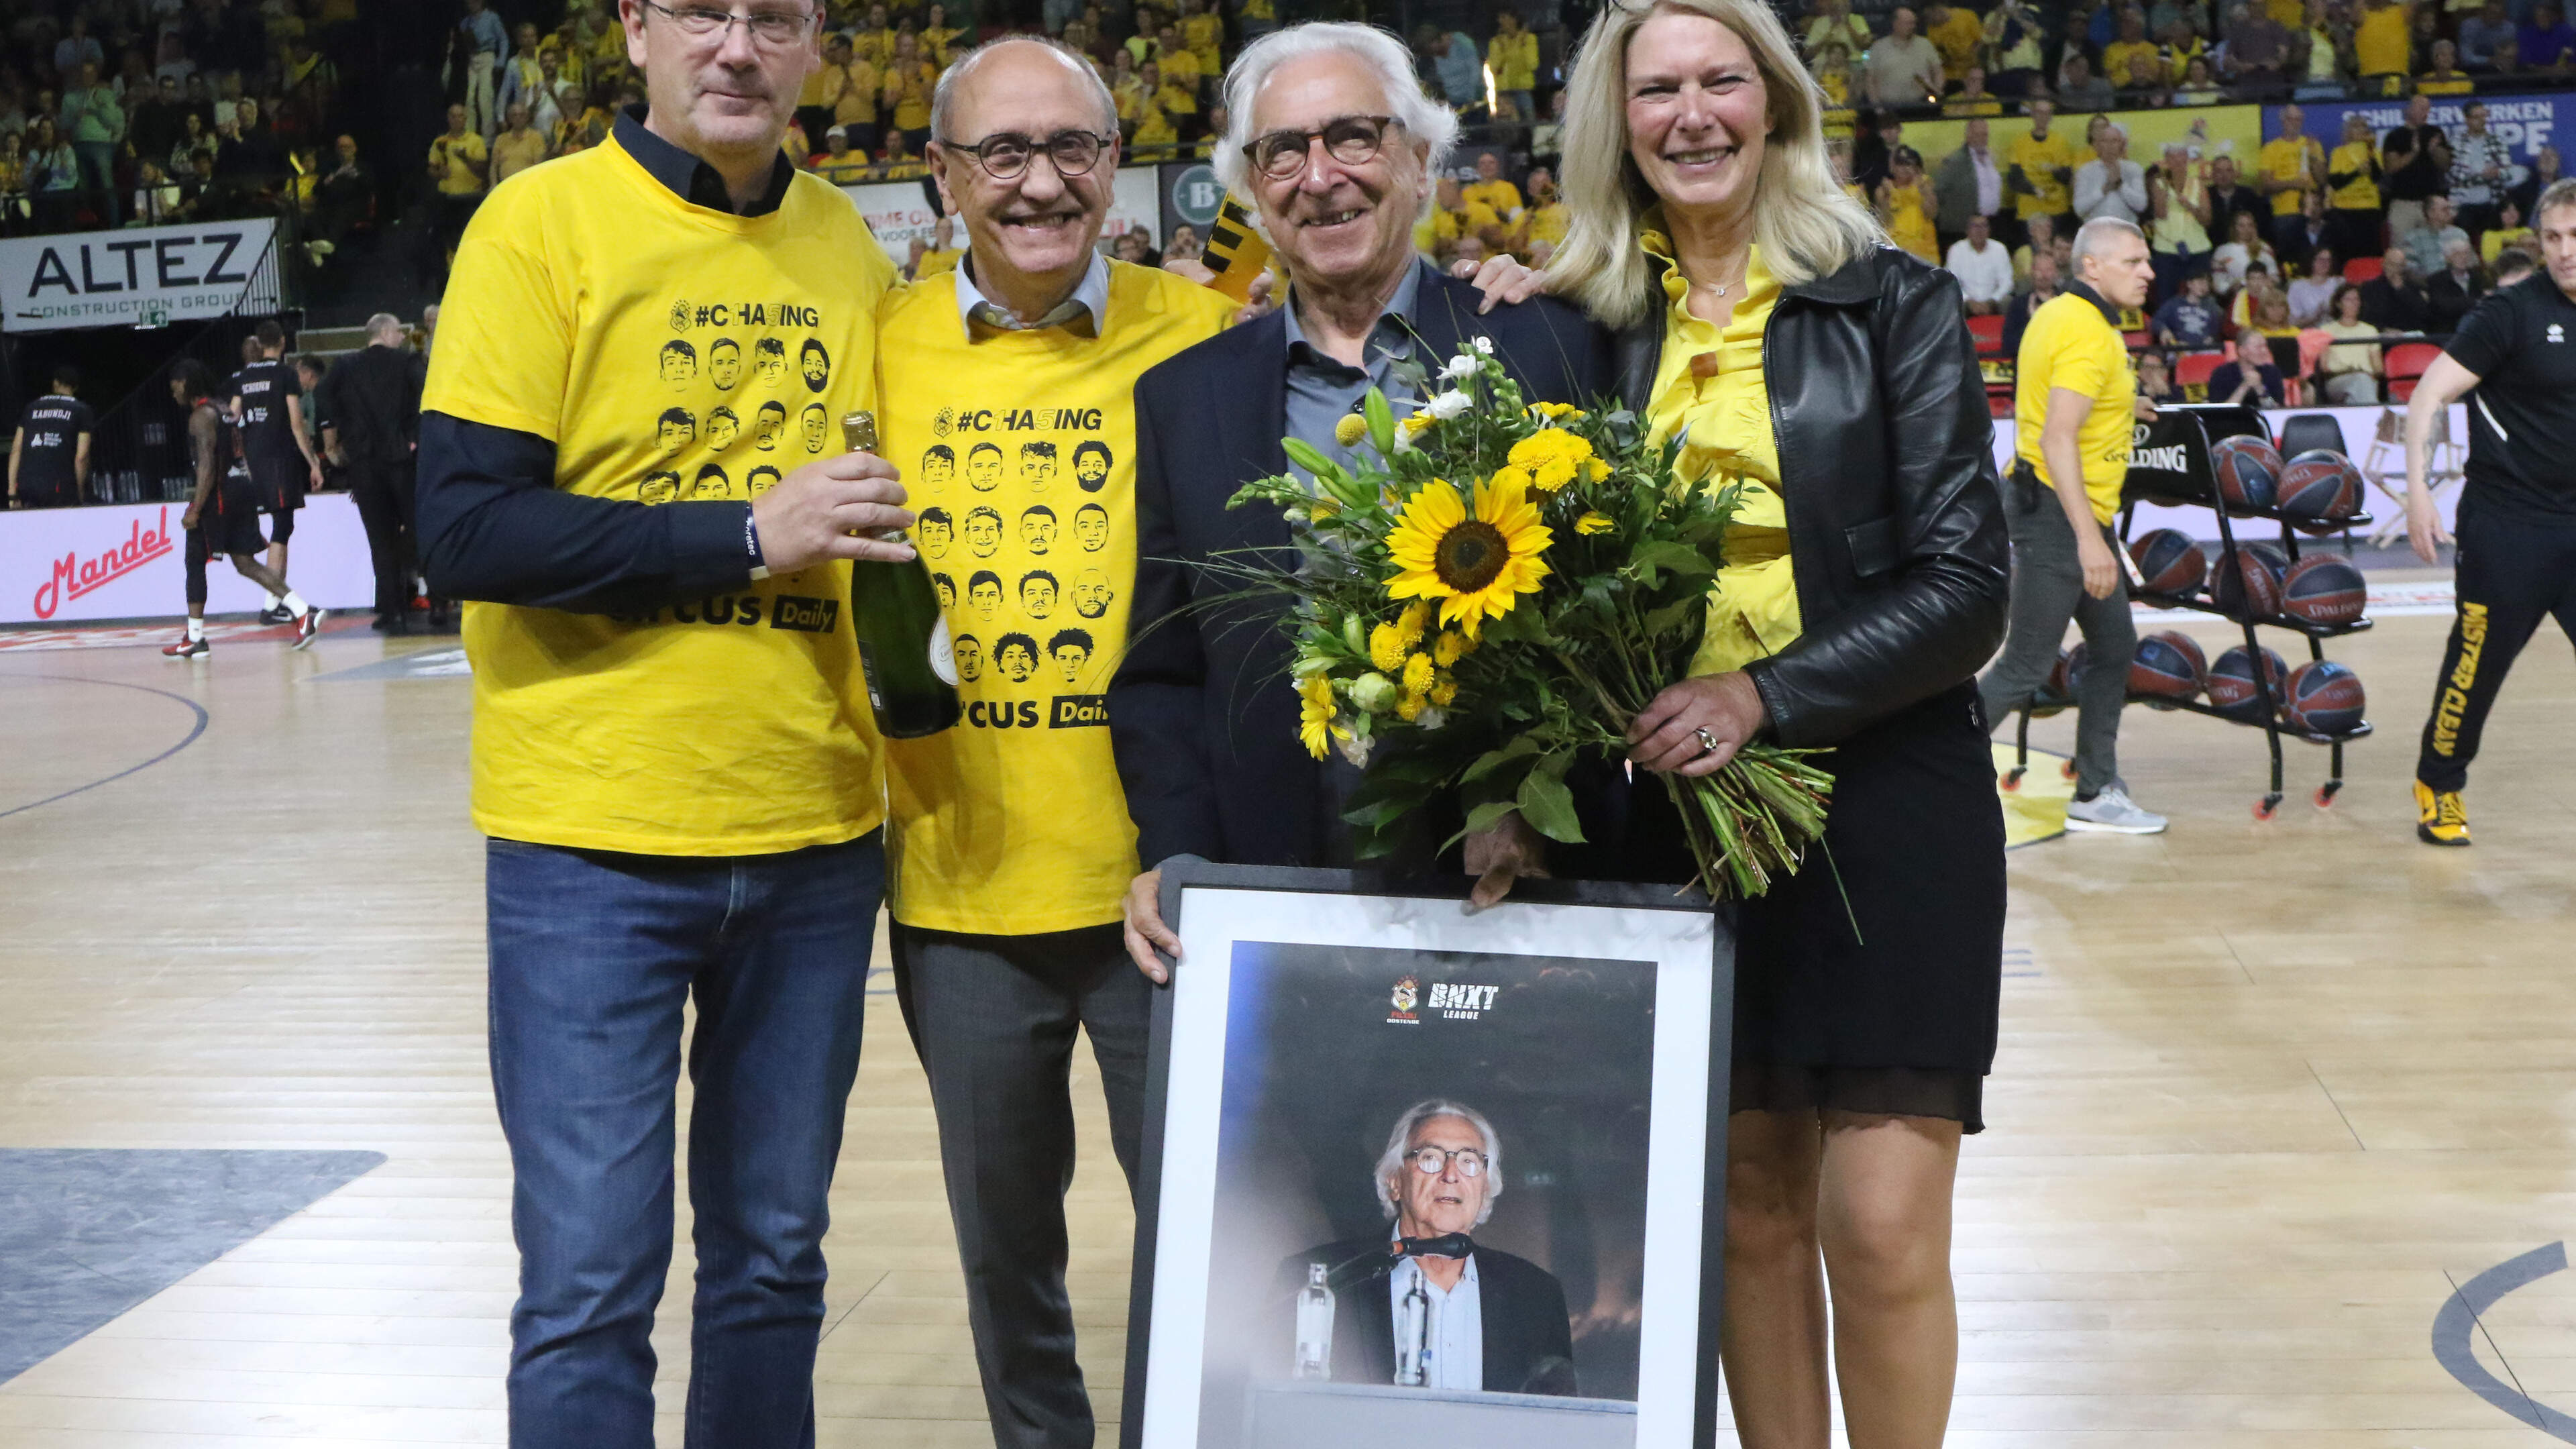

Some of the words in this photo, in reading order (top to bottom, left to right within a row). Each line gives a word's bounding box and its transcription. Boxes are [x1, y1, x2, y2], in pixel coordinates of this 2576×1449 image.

[1189, 181, 1216, 209] B
[28, 233, 246, 298] ALTEZ
[30, 297, 173, 319] CONSTRUCTION
[2126, 443, 2187, 473] LDING
[34, 505, 172, 619] Mandel
[781, 599, 833, 633] Daily
[2451, 601, 2488, 690] MISTER
[2432, 686, 2468, 757] CLEAN
[1428, 983, 1499, 1011] BNXT
[1443, 1010, 1479, 1020] LEAGUE
